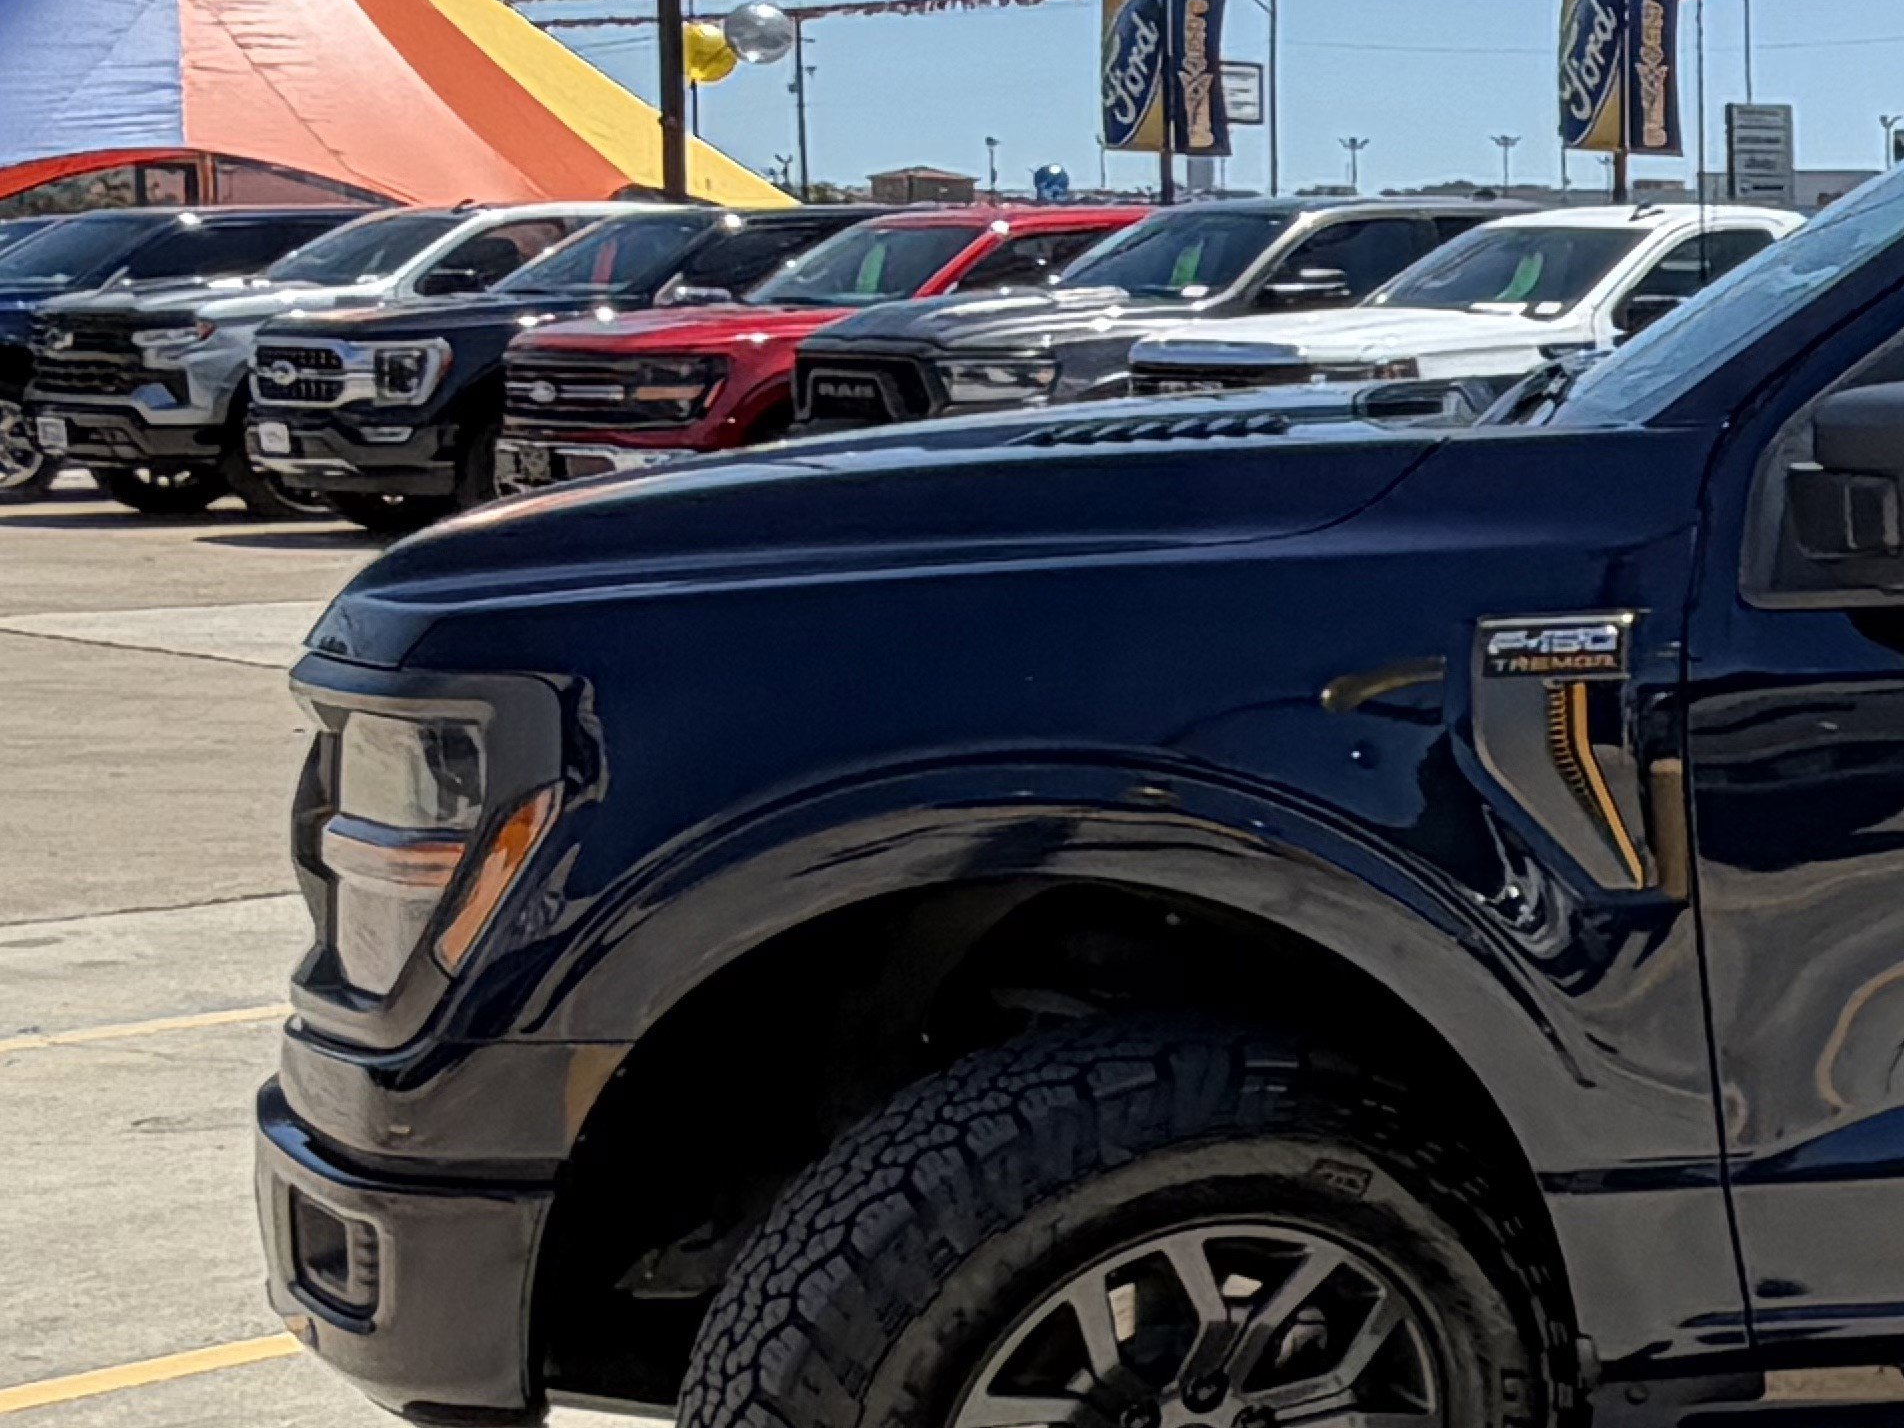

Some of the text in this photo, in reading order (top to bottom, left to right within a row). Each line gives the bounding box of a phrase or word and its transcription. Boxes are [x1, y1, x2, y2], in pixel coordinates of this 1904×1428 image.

[1102, 11, 1159, 124] Ford
[1488, 626, 1618, 654] F-150
[1492, 655, 1617, 672] TREMOR
